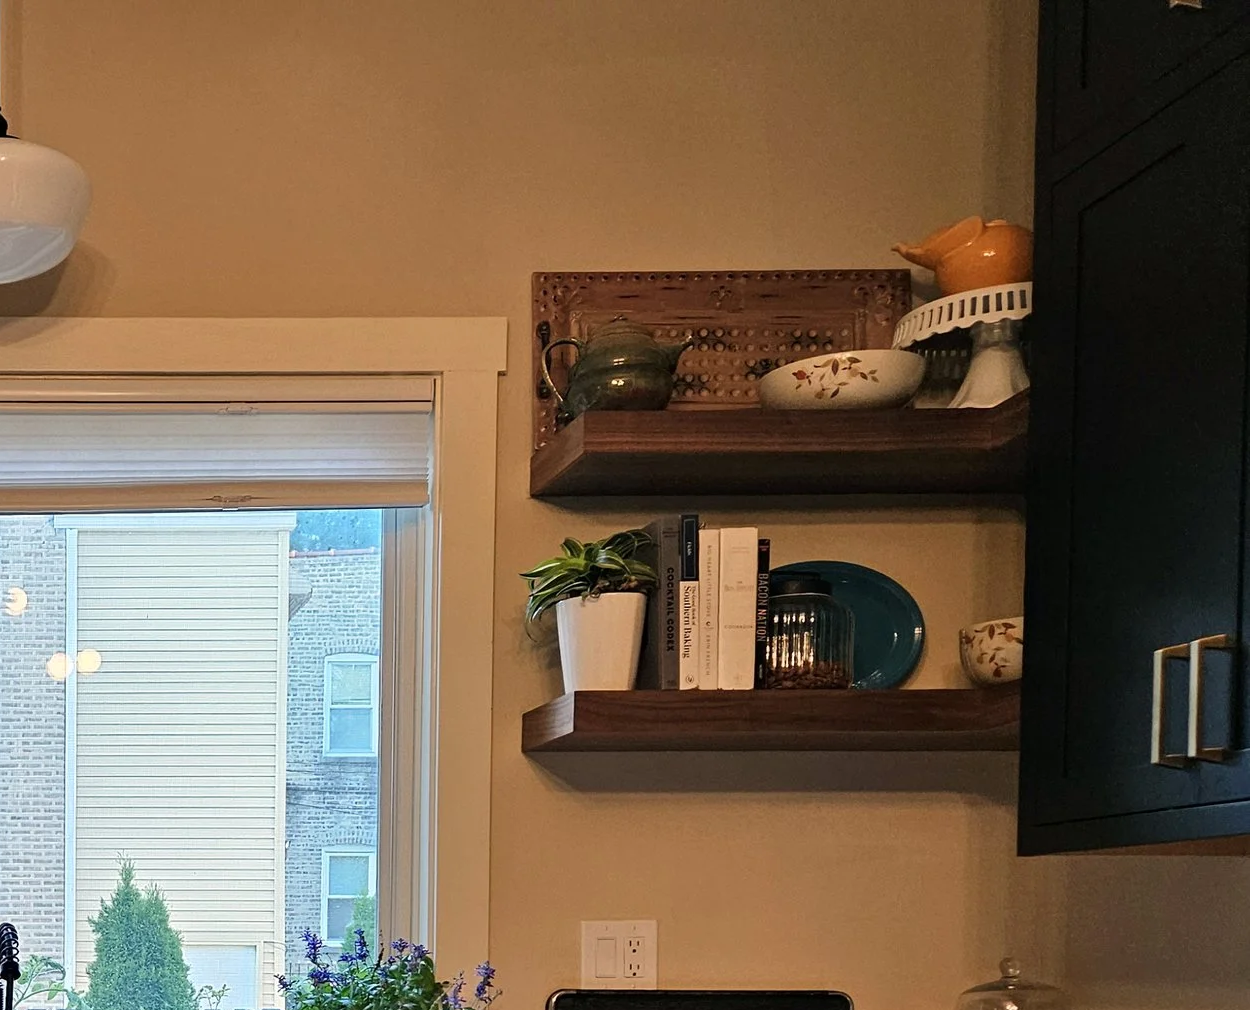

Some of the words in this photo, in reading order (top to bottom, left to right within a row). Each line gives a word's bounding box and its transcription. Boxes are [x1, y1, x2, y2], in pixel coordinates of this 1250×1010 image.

[667, 567, 675, 616] COCKTAIL
[683, 586, 692, 625] Southern
[758, 573, 769, 606] BACON
[667, 619, 675, 651] CODEX
[757, 608, 769, 642] NATION
[682, 627, 692, 659] Baking
